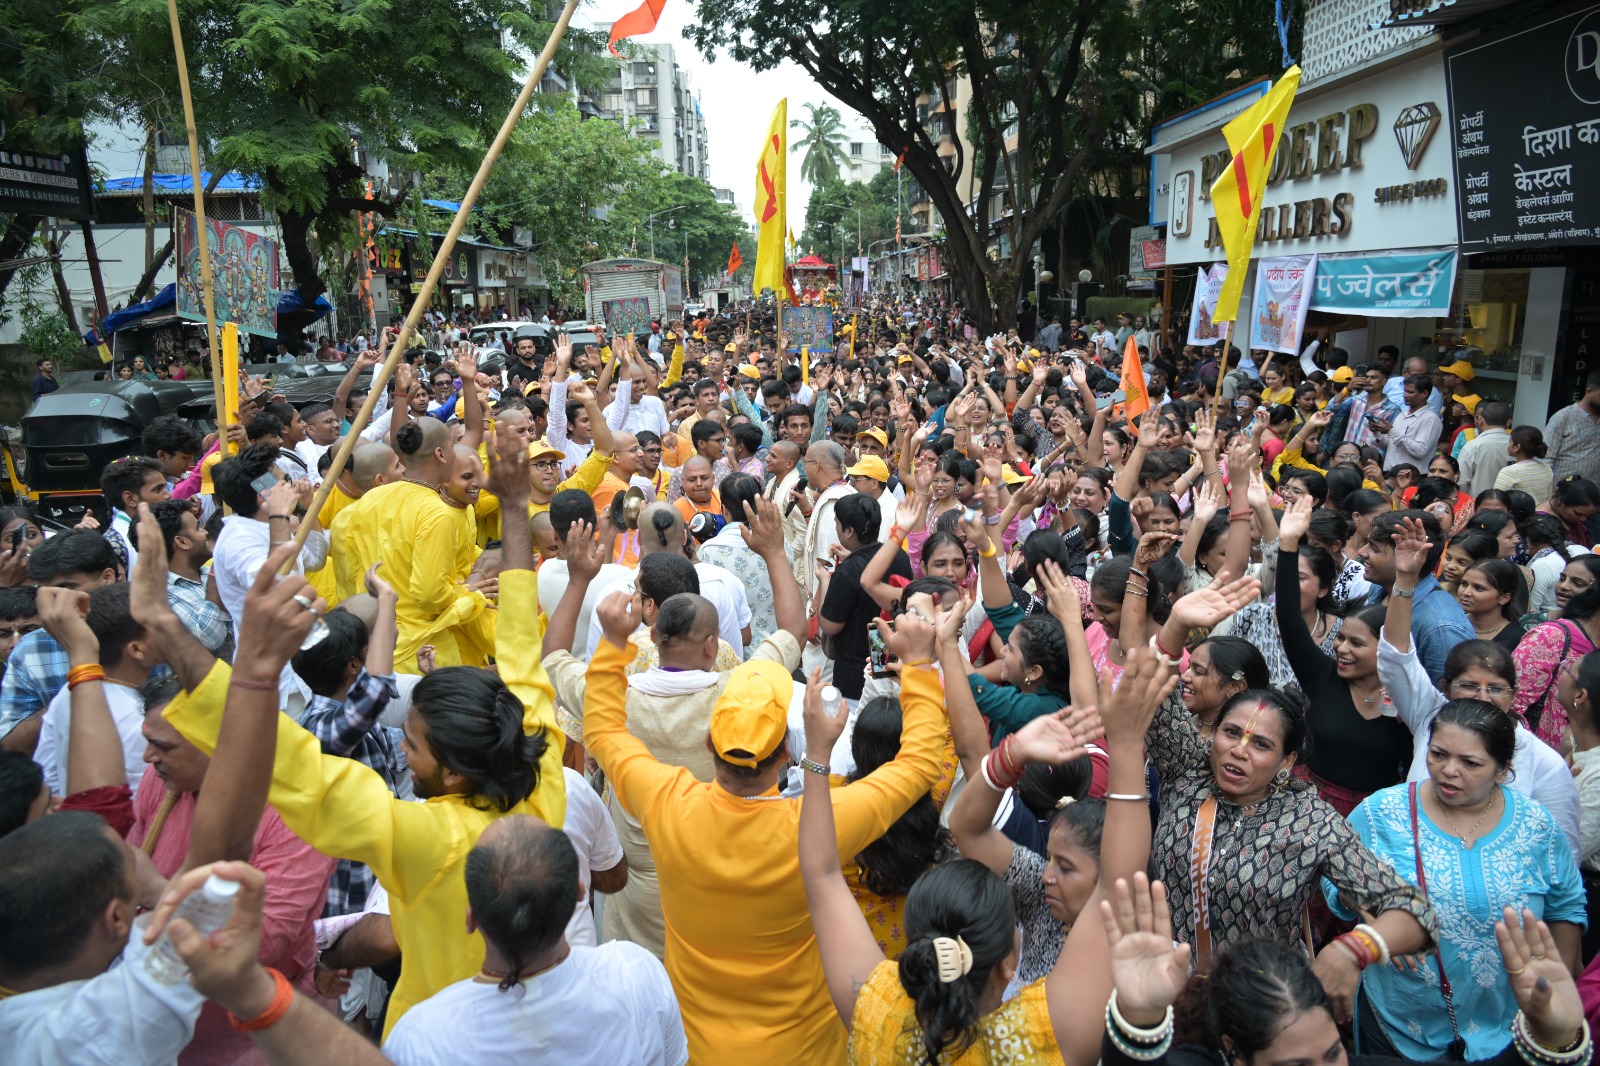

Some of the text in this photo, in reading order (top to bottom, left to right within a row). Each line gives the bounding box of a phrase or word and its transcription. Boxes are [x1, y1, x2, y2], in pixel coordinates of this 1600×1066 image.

[1199, 102, 1379, 201] PDEEP
[1522, 125, 1573, 157] दिशा
[1513, 163, 1573, 192] केस्टल
[1204, 192, 1355, 249] JLLERS
[1515, 253, 1567, 263] TAILORING
